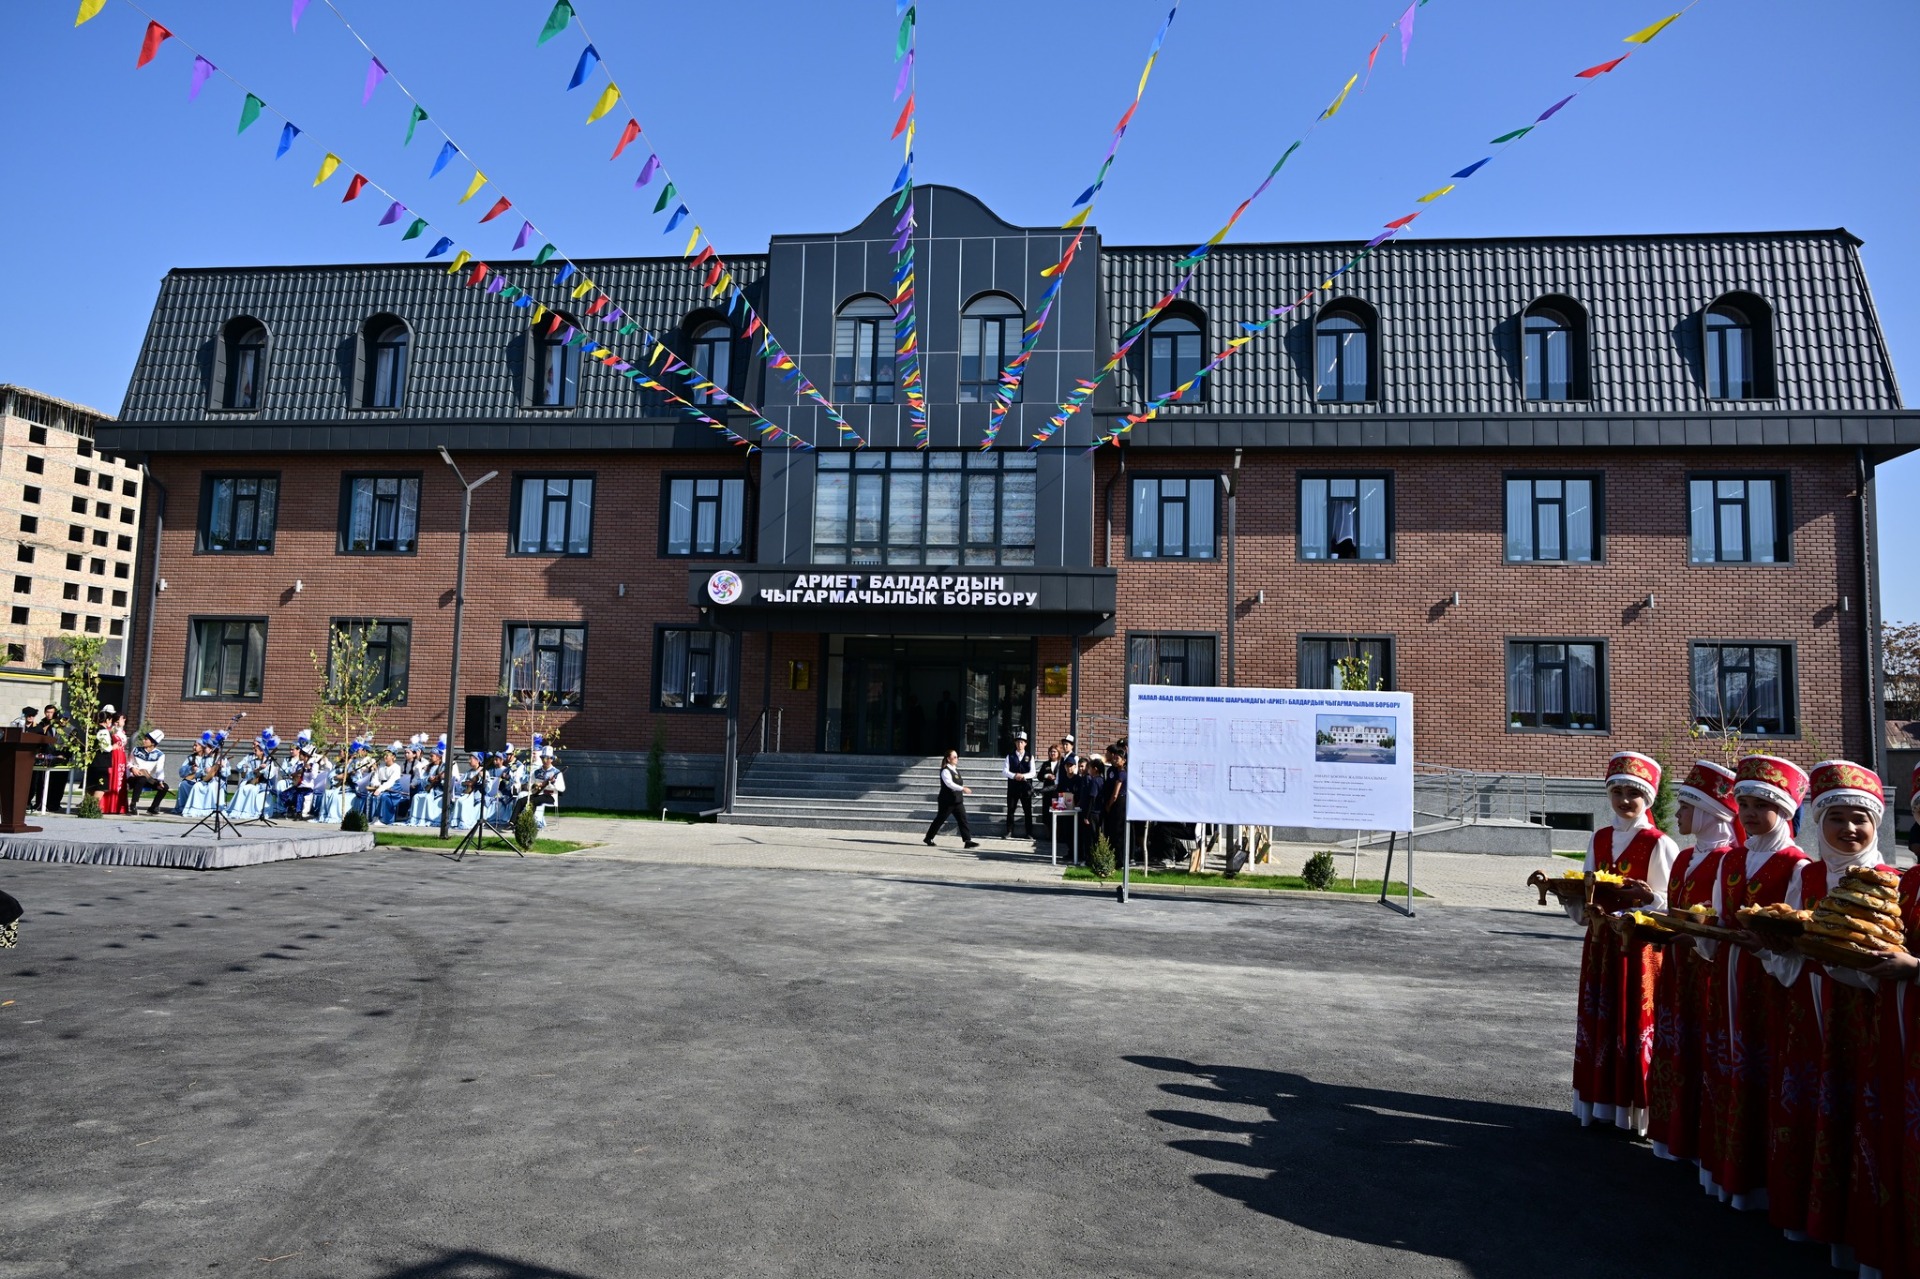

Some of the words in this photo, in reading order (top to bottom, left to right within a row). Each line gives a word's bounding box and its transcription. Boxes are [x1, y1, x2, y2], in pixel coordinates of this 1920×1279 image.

[794, 574, 861, 588] АРИЕТ
[869, 575, 1003, 592] БАЛДАРДЫН
[760, 589, 937, 604] ЧЫГАРМАЧЫЛЫК
[943, 592, 1037, 606] БОРБОРУ
